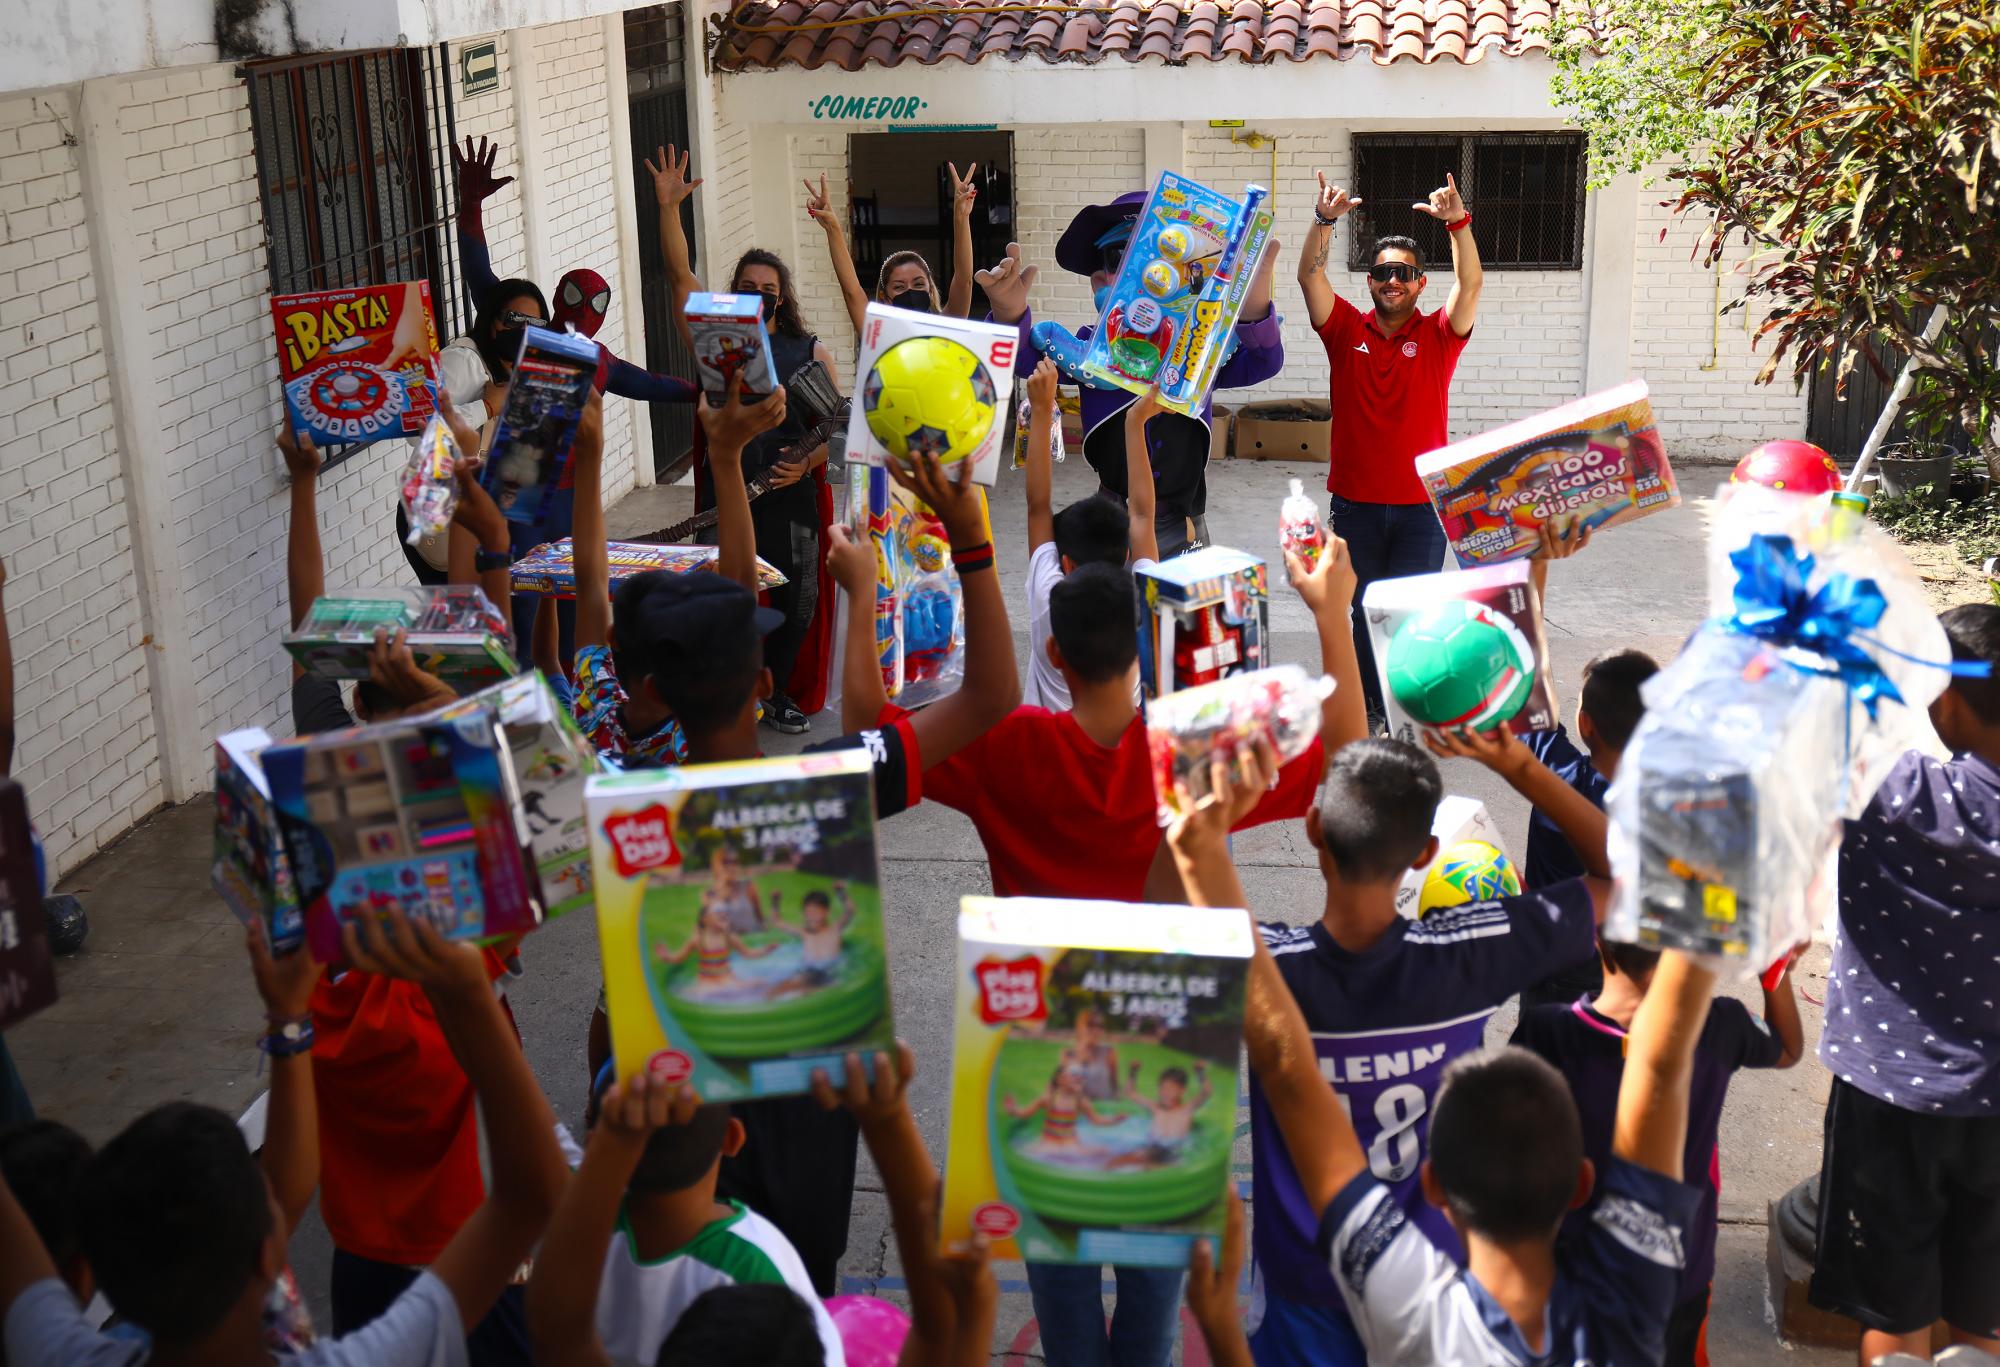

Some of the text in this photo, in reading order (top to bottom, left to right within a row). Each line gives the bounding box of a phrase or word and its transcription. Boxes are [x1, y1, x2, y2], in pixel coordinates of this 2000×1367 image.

[813, 94, 921, 120] COMEDOR
[1161, 206, 1228, 239] BASEBALL
[1230, 228, 1266, 304] HAPPY BASEBALL GAME
[284, 295, 391, 373] ¡BASTA!
[1184, 300, 1223, 381] Baseball
[1552, 450, 1603, 478] 100
[1460, 526, 1512, 552] MEJORES
[1482, 538, 1515, 556] SHOW
[712, 798, 846, 829] ALBERCA DE
[613, 817, 665, 845] Play
[742, 822, 820, 849] 3 AROS
[620, 838, 672, 867] Day
[983, 965, 1037, 993] Play
[1081, 970, 1219, 998] ALBERCA DE
[988, 990, 1040, 1013] Day
[1109, 995, 1188, 1016] 3 AROS
